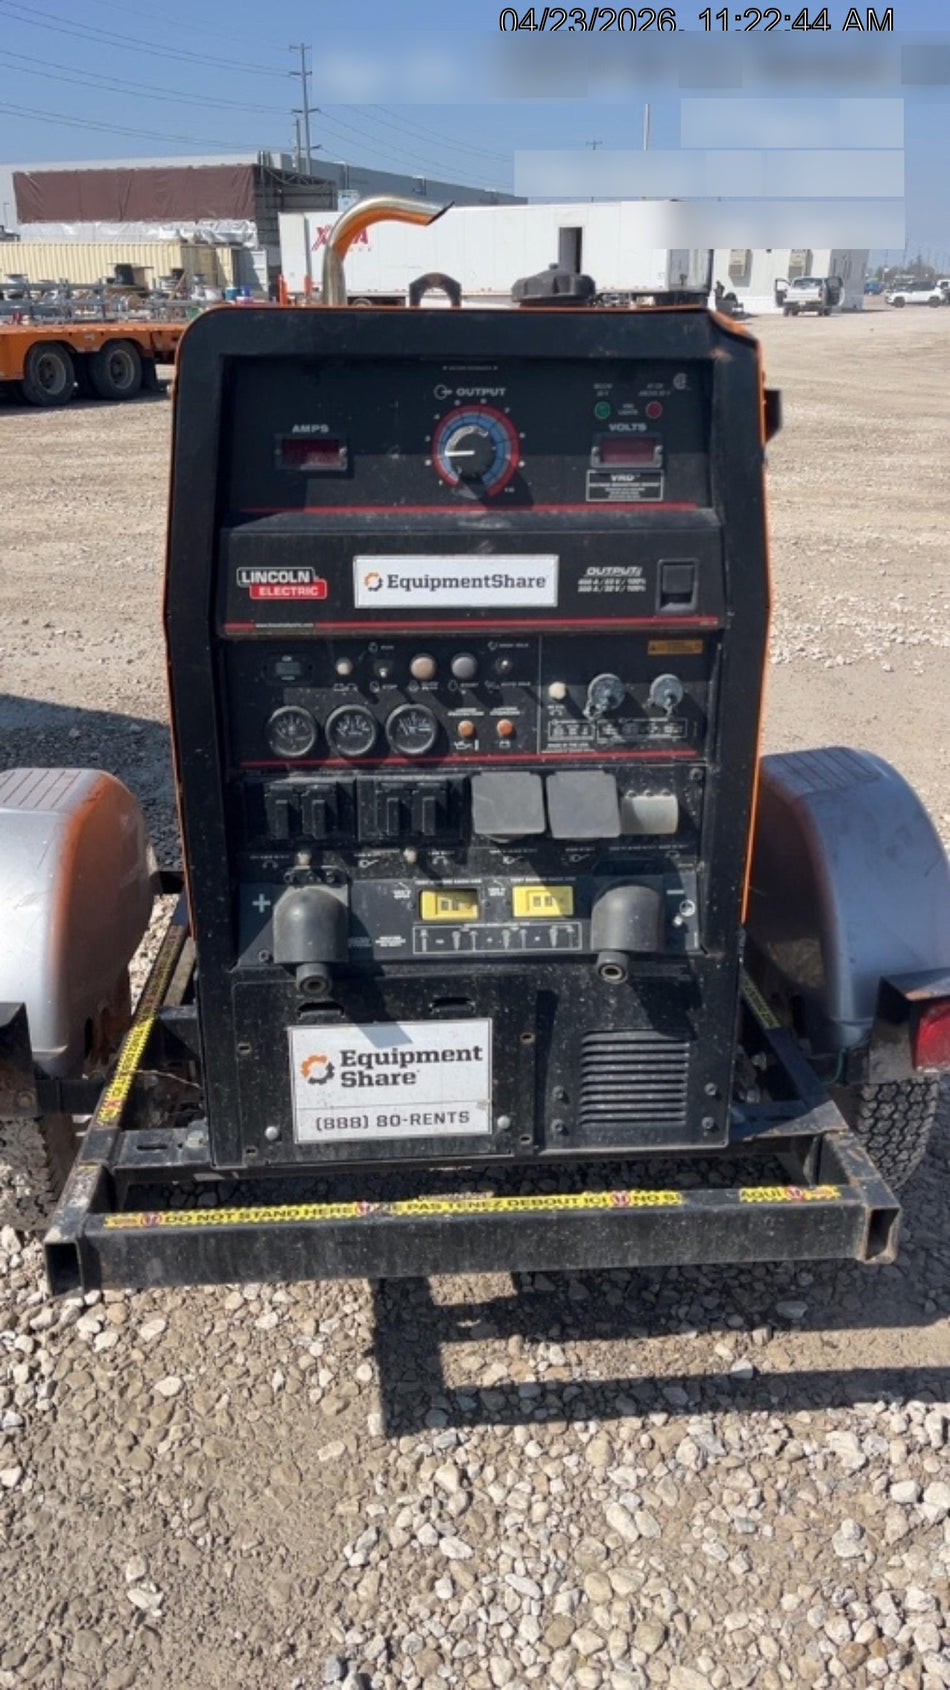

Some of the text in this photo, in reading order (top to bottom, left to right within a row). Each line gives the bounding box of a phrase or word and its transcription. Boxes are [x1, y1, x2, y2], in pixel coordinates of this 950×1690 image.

[456, 387, 506, 397] OUTPUT
[292, 424, 330, 434] AMPS
[608, 422, 647, 433] VOLTS
[241, 570, 311, 584] LINCOLN
[387, 573, 547, 590] EquipmentShare
[258, 586, 319, 597] ELECTRIC
[340, 1046, 484, 1069] Equipment
[341, 1070, 417, 1088] Share
[316, 1111, 470, 1131] (888) 80-RENTS
[507, 1198, 579, 1206] DEBOUT
[165, 1206, 352, 1223] DO NOT STAND HERE
